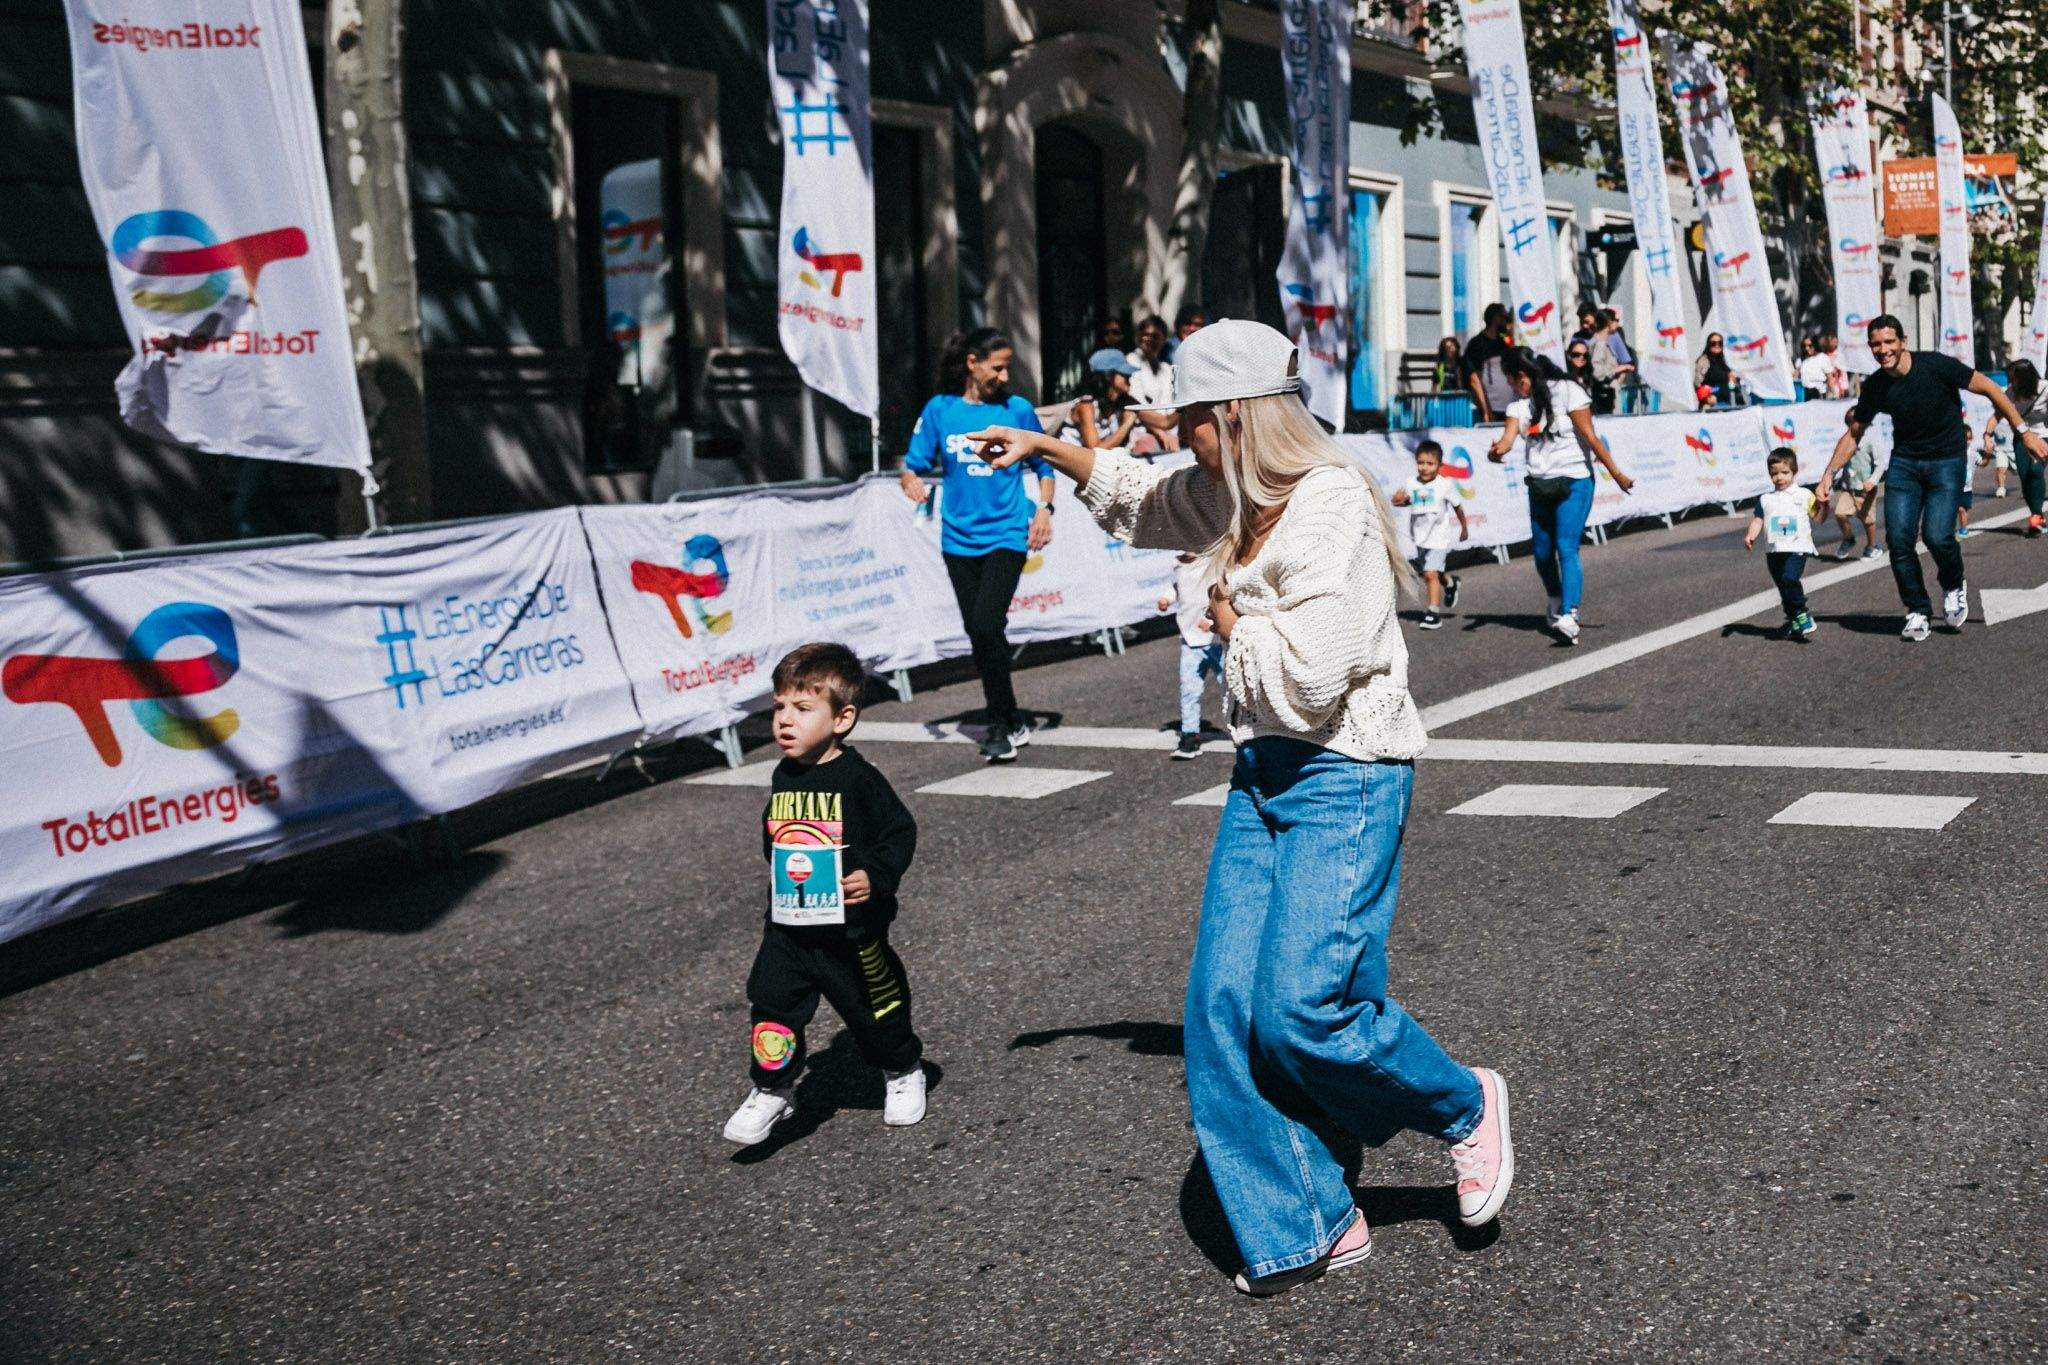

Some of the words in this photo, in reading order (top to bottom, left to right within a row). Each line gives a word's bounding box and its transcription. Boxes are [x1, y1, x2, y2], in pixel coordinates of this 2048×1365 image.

[416, 583, 570, 641] LaEnergaDe
[41, 773, 281, 858] TotalEnergies
[767, 791, 844, 821] NIRVANA
